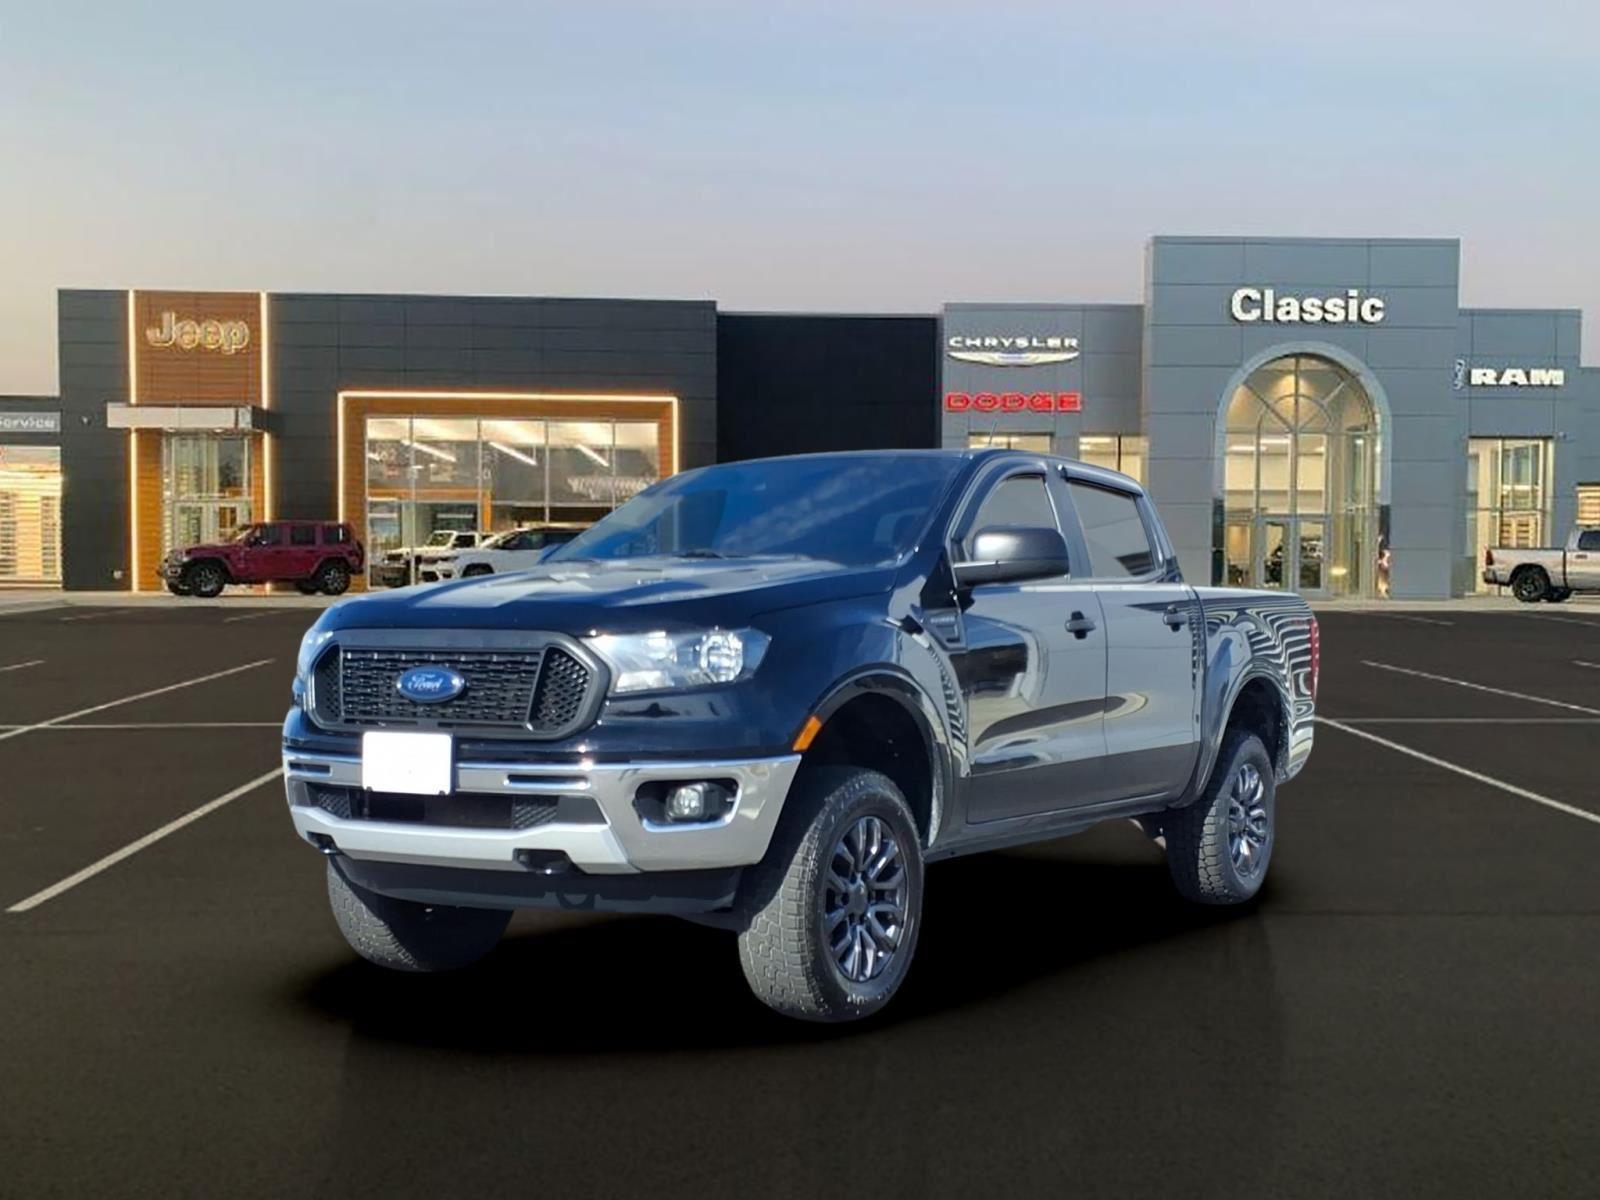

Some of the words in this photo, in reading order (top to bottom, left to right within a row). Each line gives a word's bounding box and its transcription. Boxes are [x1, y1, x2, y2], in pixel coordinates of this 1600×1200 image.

[1231, 288, 1386, 322] Classic
[145, 311, 250, 355] Jeep
[948, 335, 1080, 349] CHRYSLER
[1470, 368, 1564, 386] RAM
[945, 391, 1082, 412] DODGE
[407, 673, 444, 692] Ford
